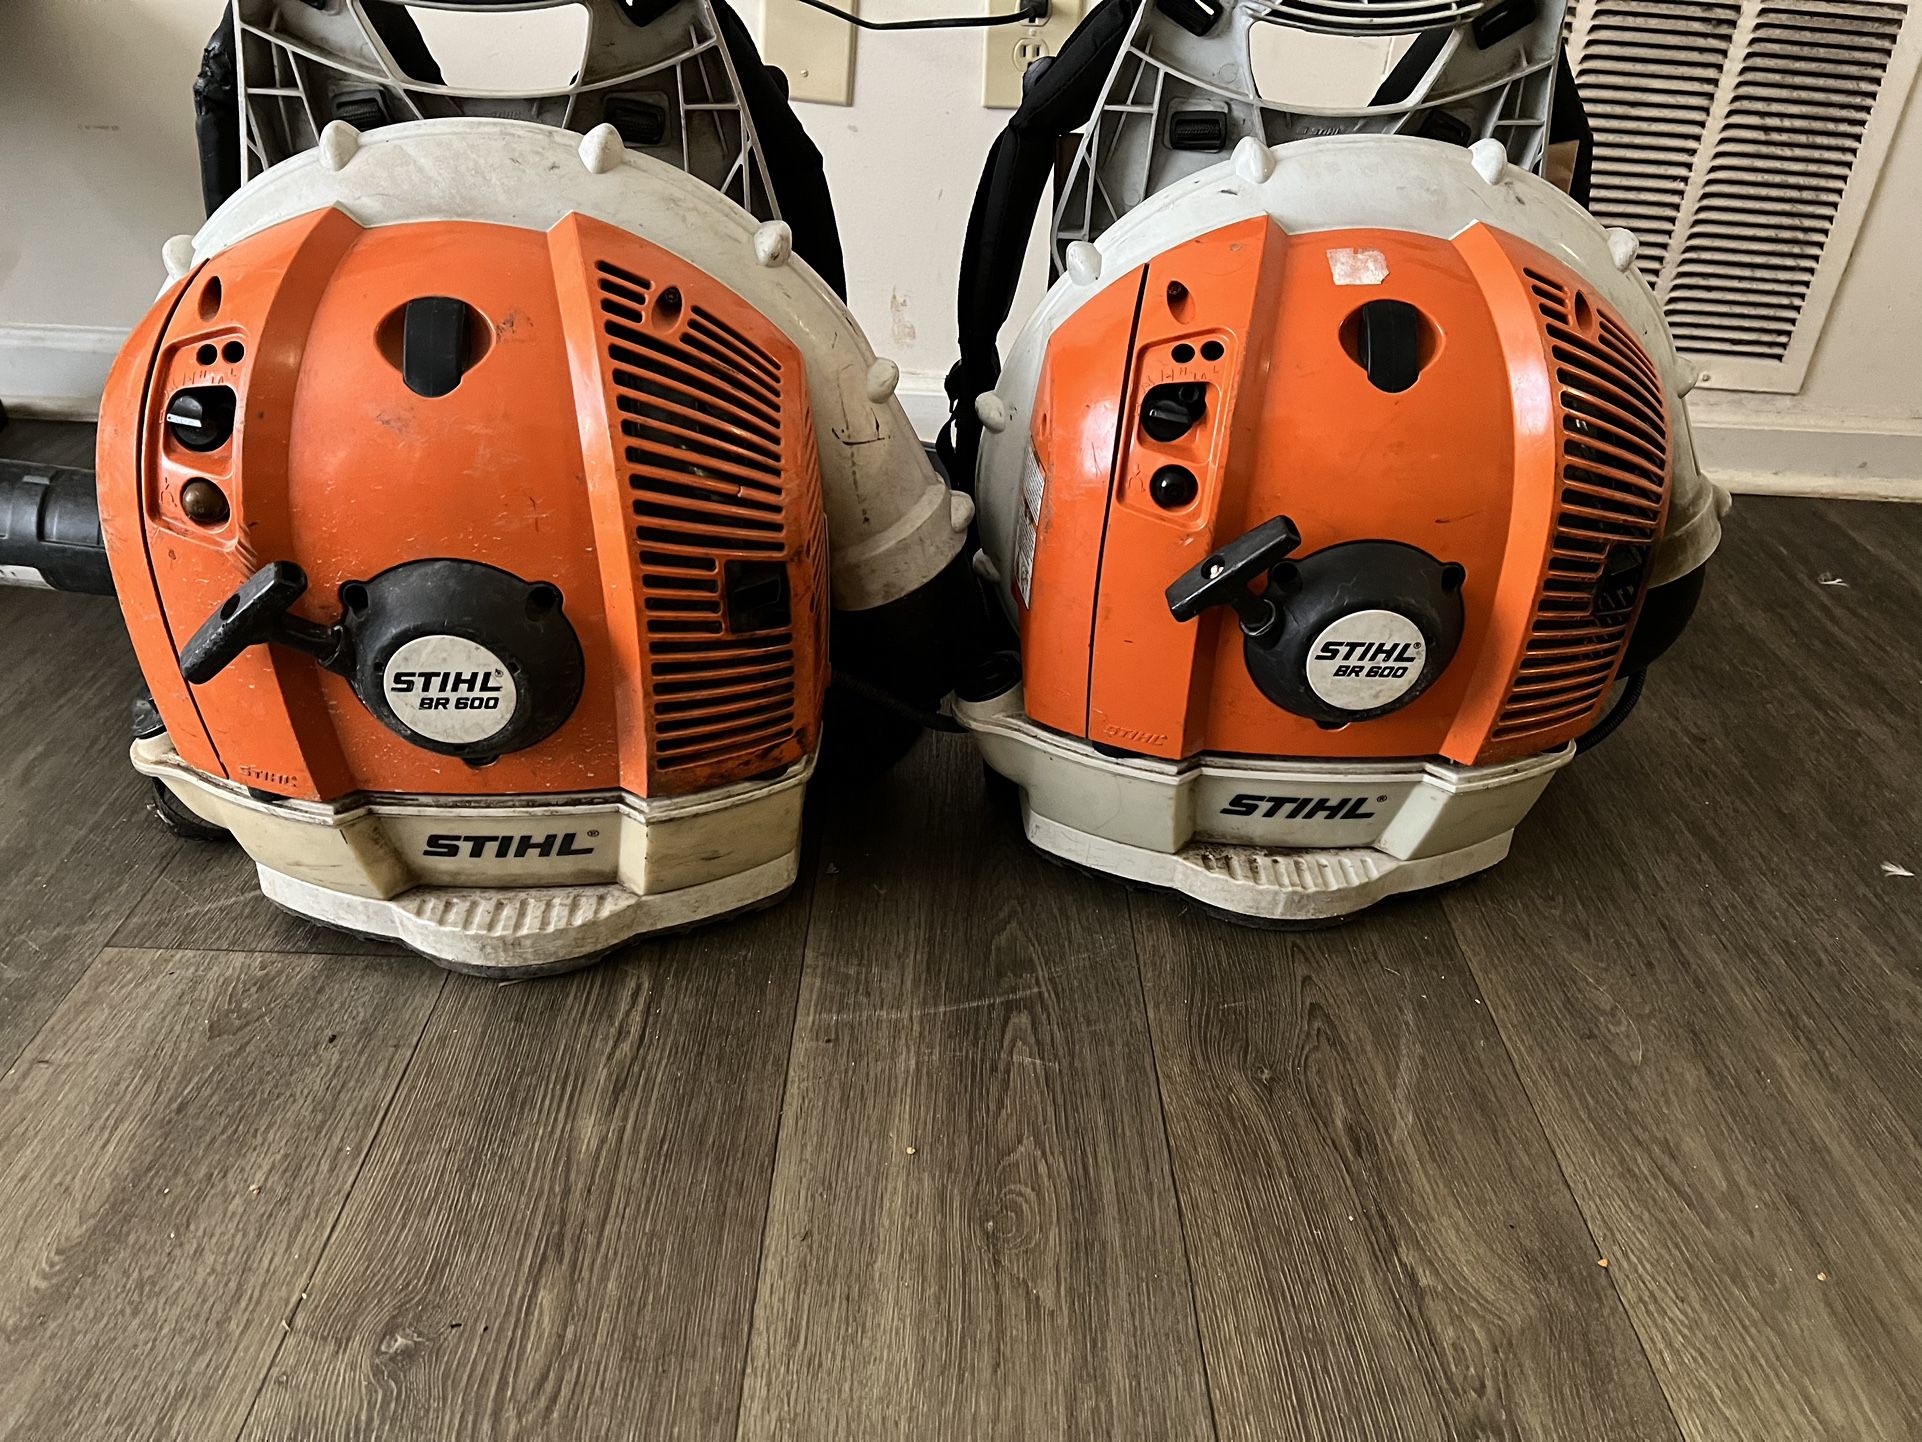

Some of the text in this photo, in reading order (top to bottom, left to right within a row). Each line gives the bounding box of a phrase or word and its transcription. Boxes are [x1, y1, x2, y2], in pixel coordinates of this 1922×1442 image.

[1314, 641, 1416, 662] STIHL
[390, 671, 503, 692] STIHL
[1333, 665, 1409, 678] BR 600
[419, 697, 500, 710] BR 600
[1219, 794, 1376, 819] STIHL
[422, 832, 594, 858] STIHL
